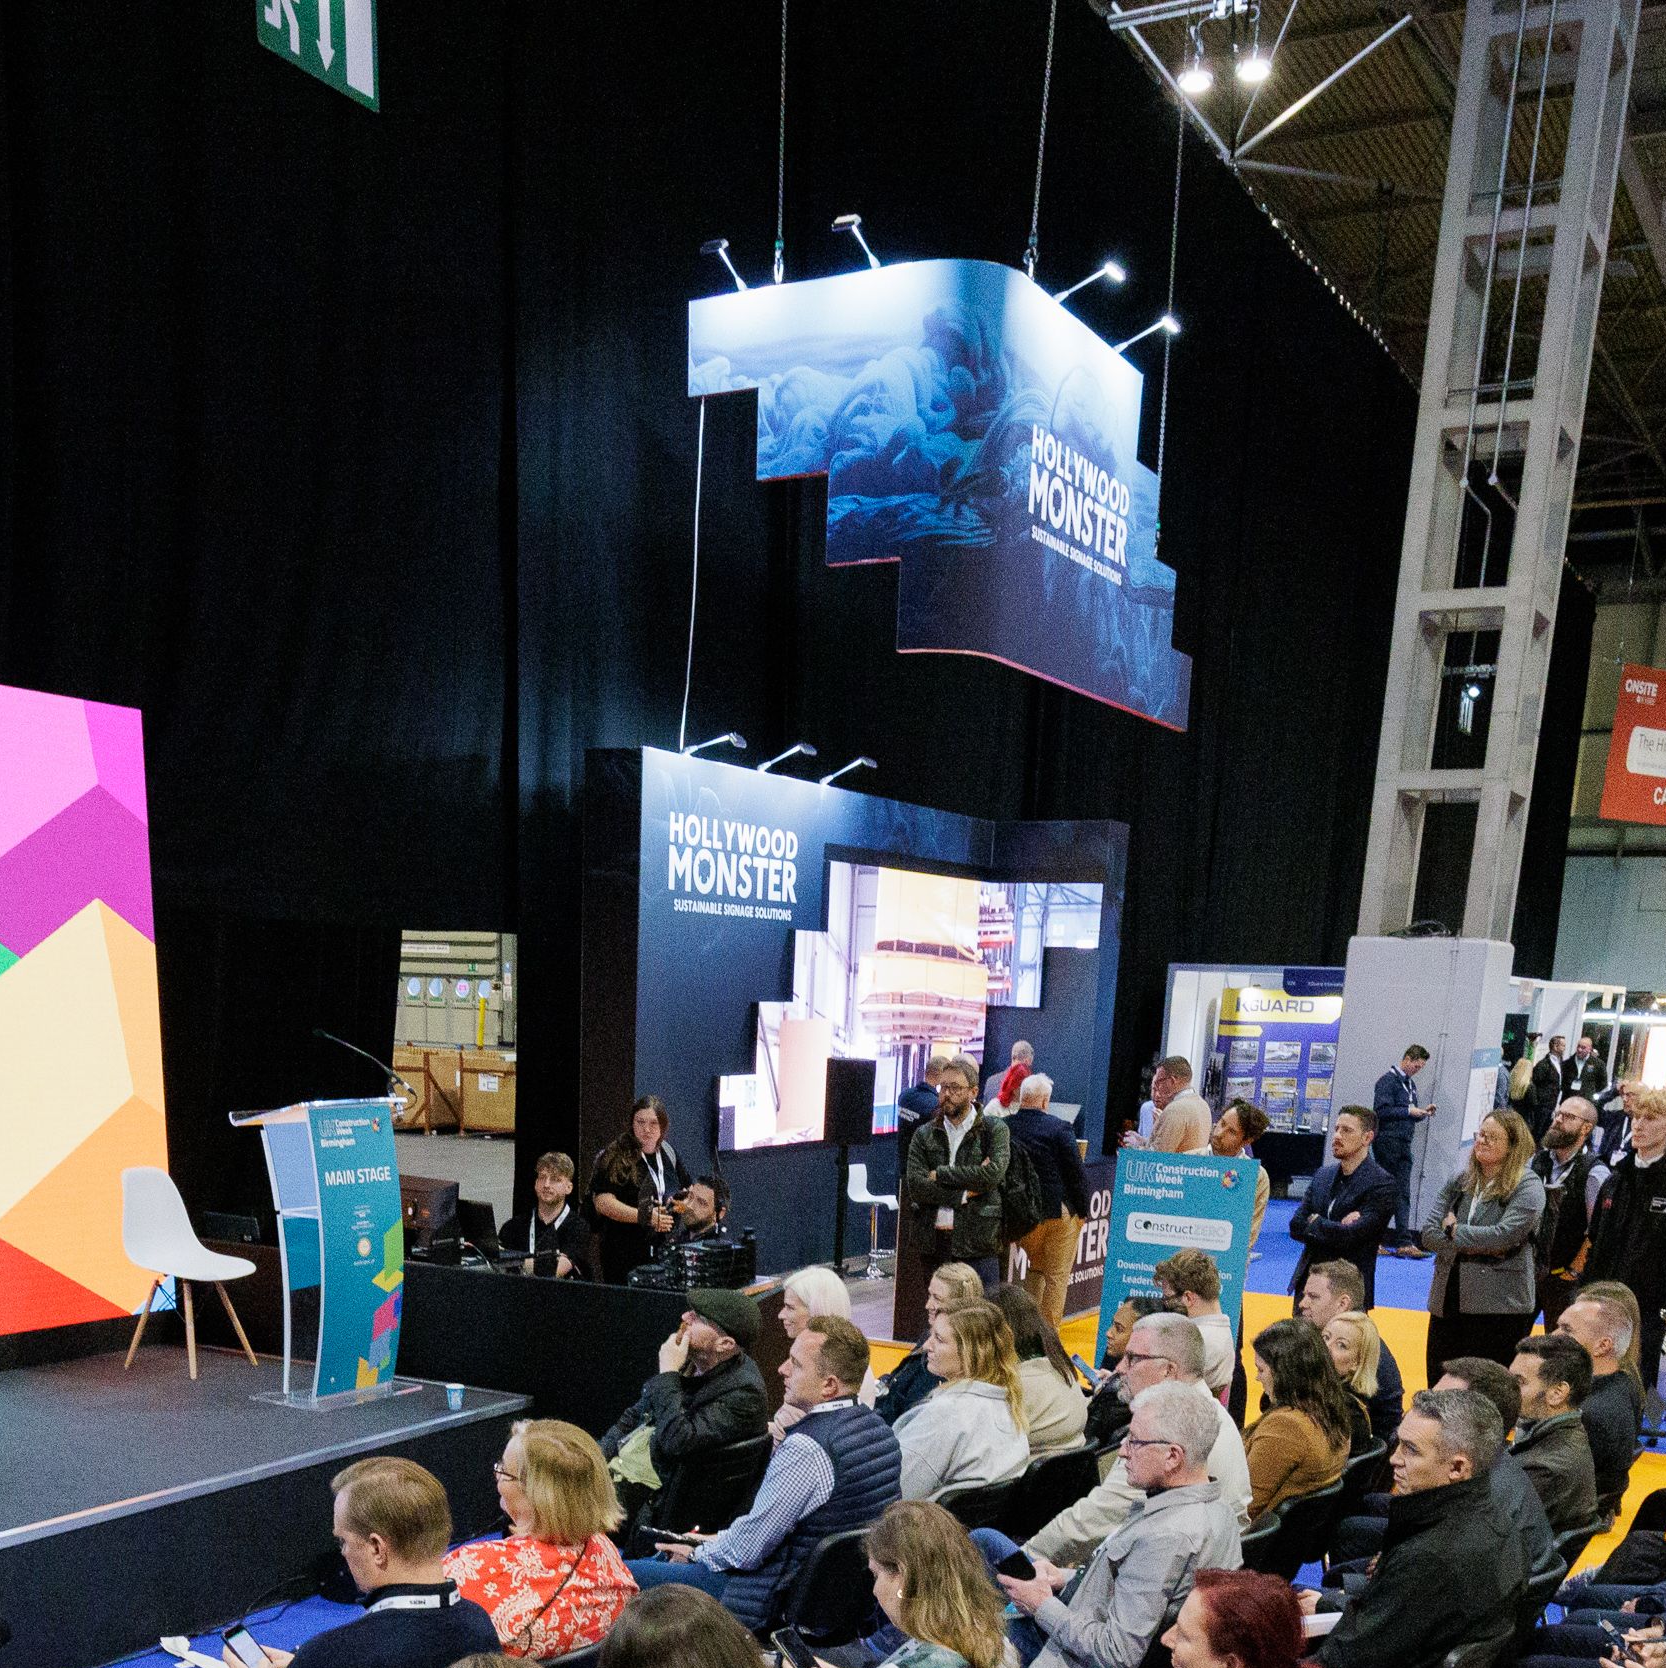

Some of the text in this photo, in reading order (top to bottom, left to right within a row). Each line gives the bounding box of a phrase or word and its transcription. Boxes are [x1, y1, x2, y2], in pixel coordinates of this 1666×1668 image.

[1032, 424, 1130, 517] HOLLYWOOD
[1028, 462, 1128, 567] MONSTER
[1031, 525, 1123, 586] SUSTAINABLE SIGNAGE SOLUTIONS
[1625, 679, 1659, 697] ONSITE
[1639, 733, 1654, 748] The
[669, 811, 798, 860] HOLLYWOOD
[668, 844, 797, 904] MONSTER
[673, 898, 792, 921] SUSTAINABLE SIGNAGE SOLUTIONS
[1236, 997, 1314, 1013] KGUARD
[324, 1166, 392, 1186] MAIN STAGE
[1126, 1160, 1219, 1182] UK Construction
[1155, 1173, 1183, 1185] Week
[1124, 1184, 1184, 1200] Birmingham
[1117, 1259, 1157, 1273] Downloa
